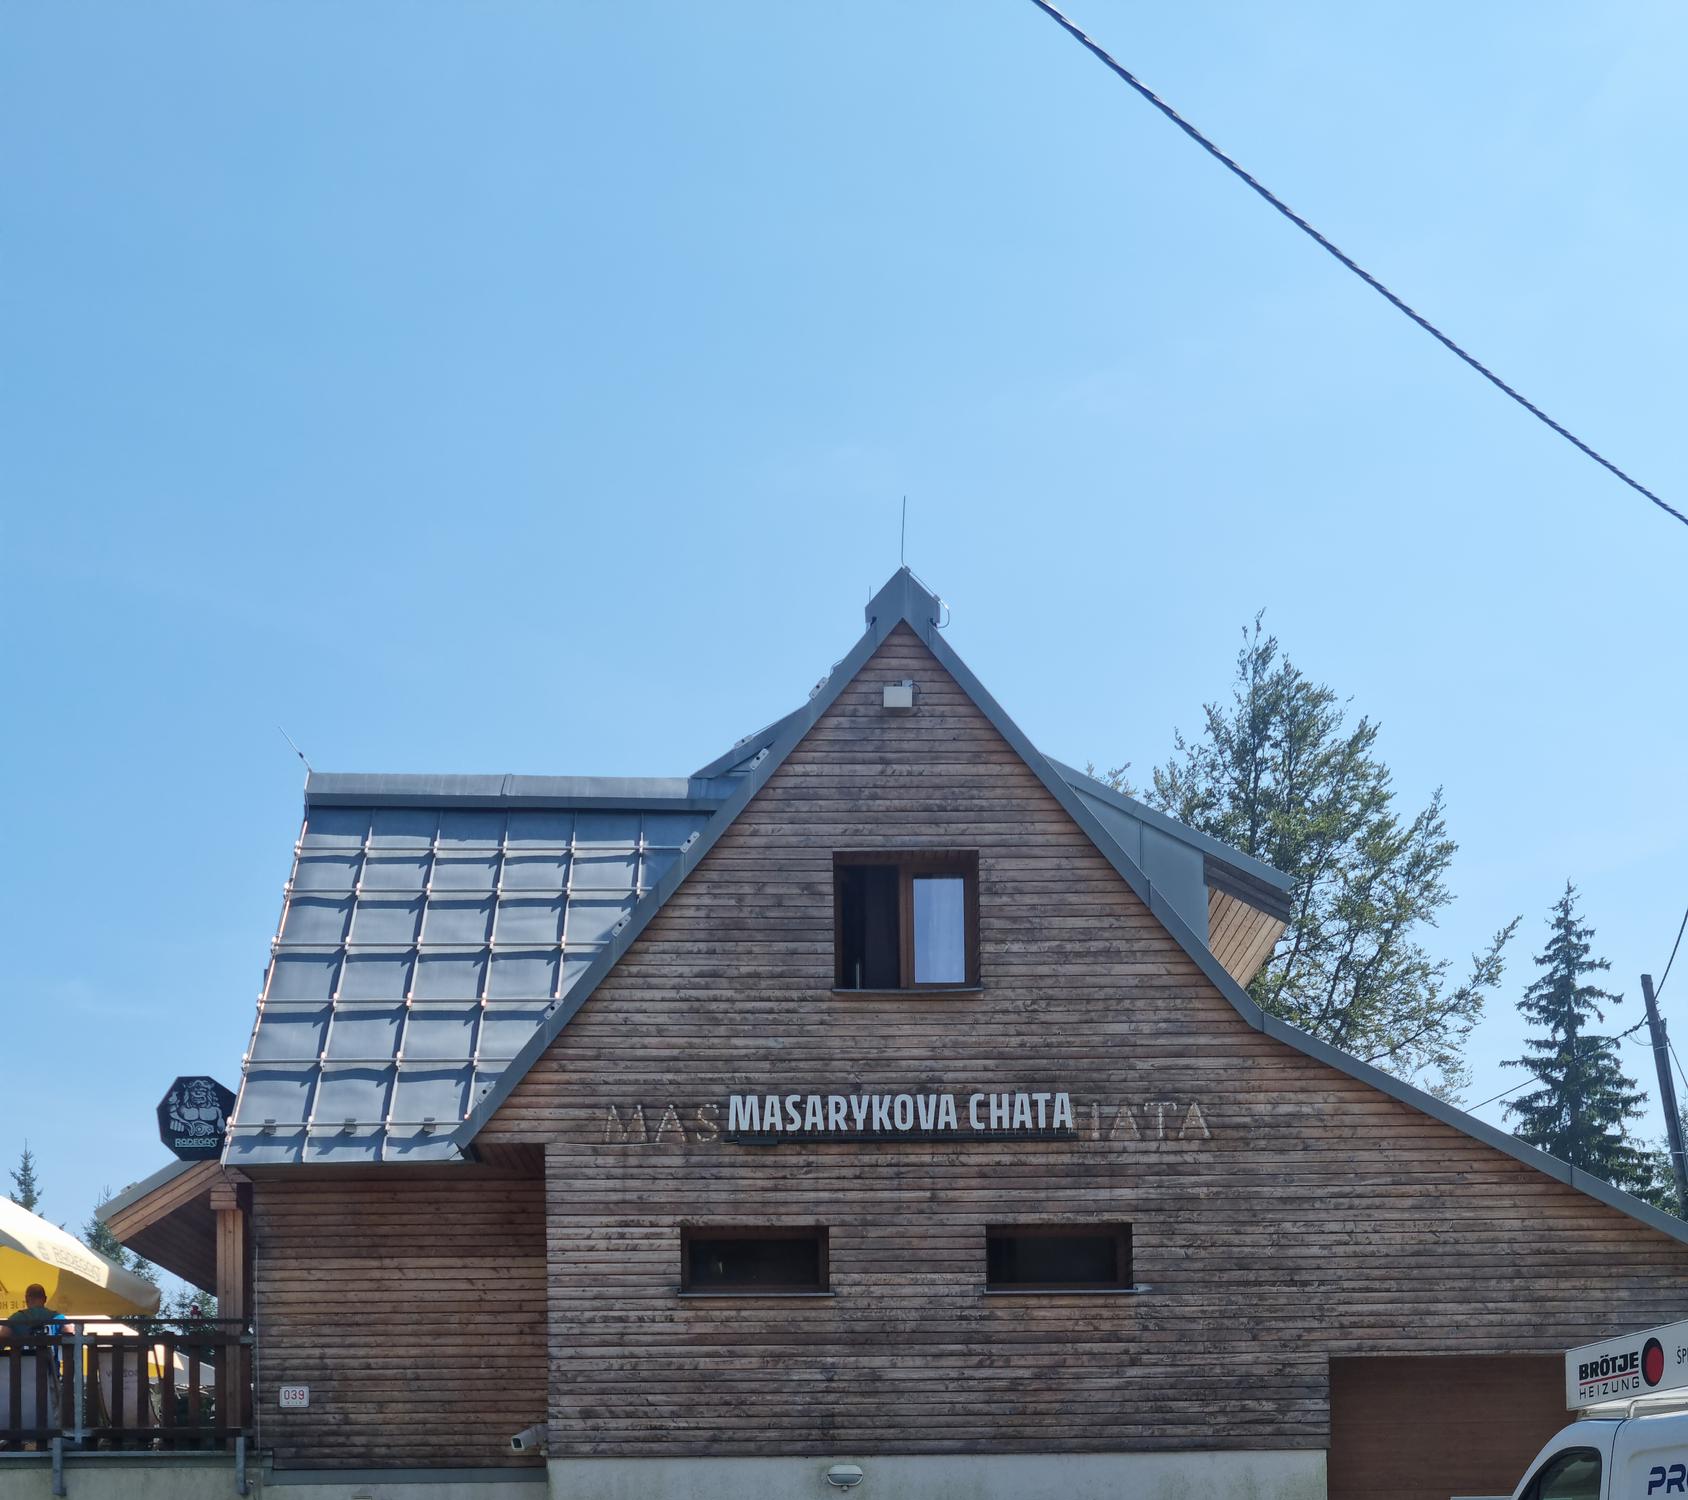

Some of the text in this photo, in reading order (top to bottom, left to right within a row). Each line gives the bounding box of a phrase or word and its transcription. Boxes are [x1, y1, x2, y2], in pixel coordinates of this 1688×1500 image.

[728, 1092, 1073, 1131] MASARYKOVA CHATA
[175, 1138, 219, 1148] RADEGAST
[1579, 1352, 1639, 1380] BRÖTJE
[1676, 1346, 1688, 1365] ŠP
[284, 1389, 305, 1400] 039
[1580, 1376, 1640, 1399] HEIZUNG
[1648, 1463, 1688, 1496] PR
